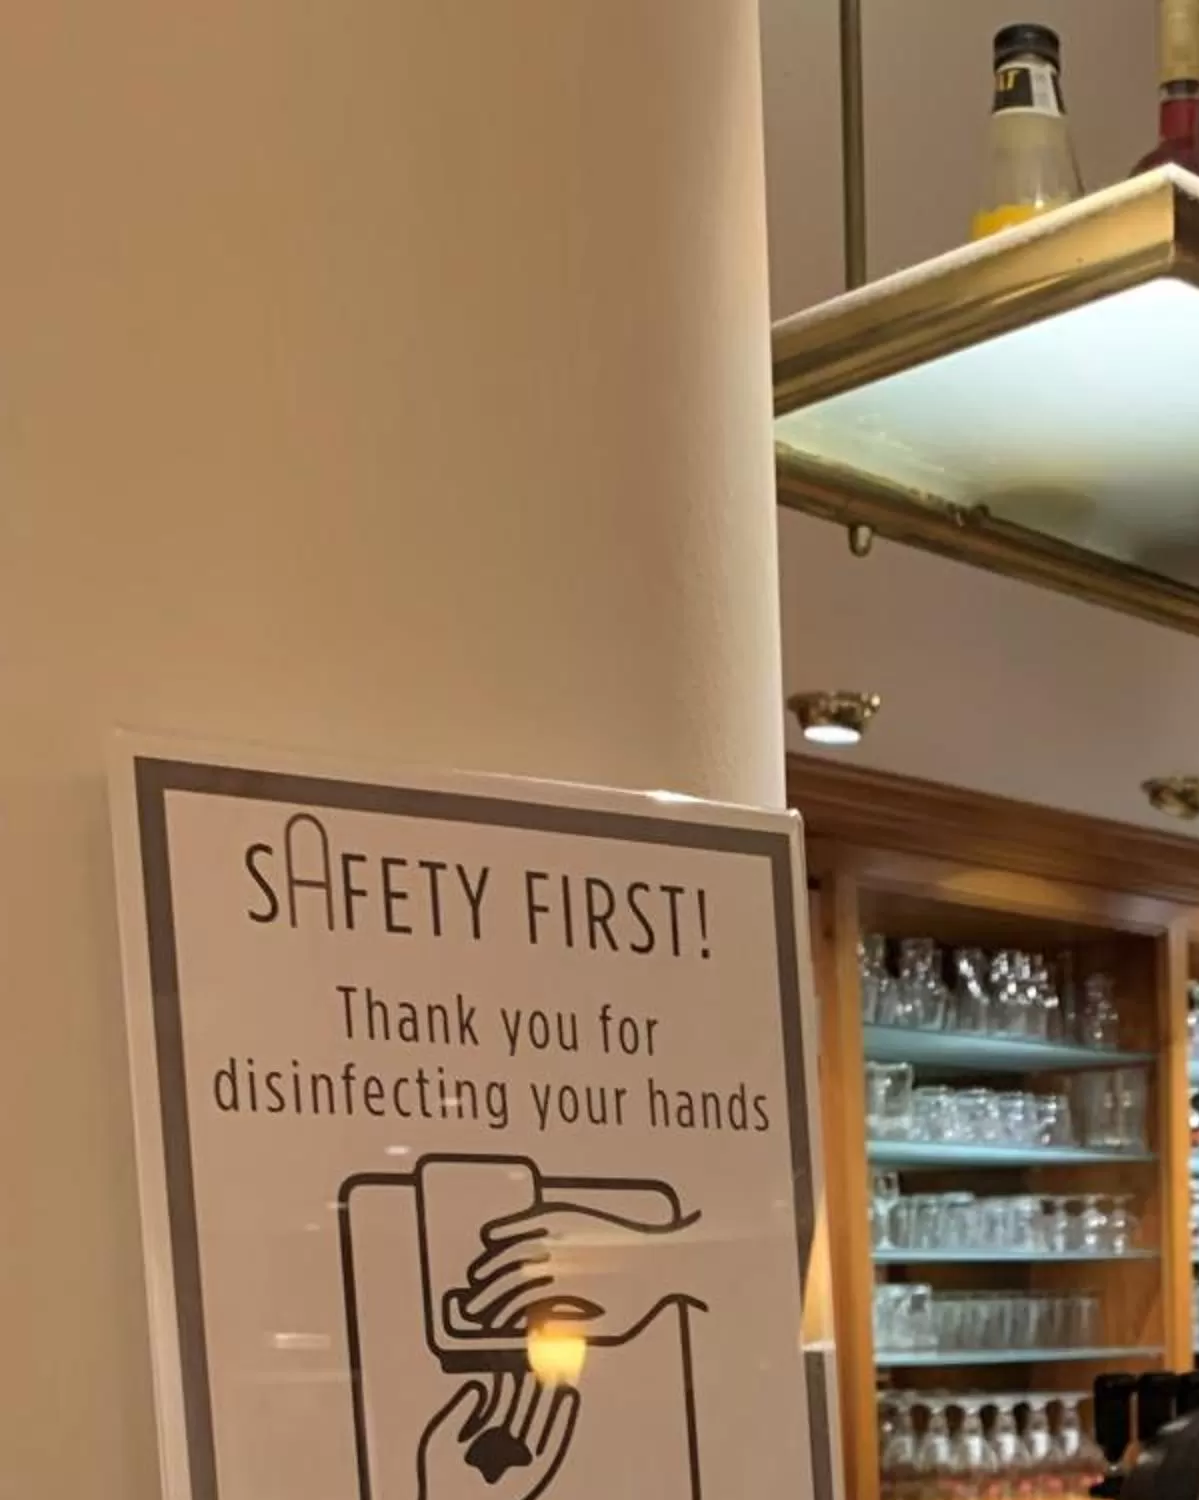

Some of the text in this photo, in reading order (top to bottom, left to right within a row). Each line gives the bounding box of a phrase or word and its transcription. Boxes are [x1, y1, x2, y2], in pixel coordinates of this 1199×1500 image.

[244, 812, 711, 960] SAFETY FIRST!
[336, 985, 658, 1058] Thank you for
[213, 1057, 770, 1133] disinfecting your hands
